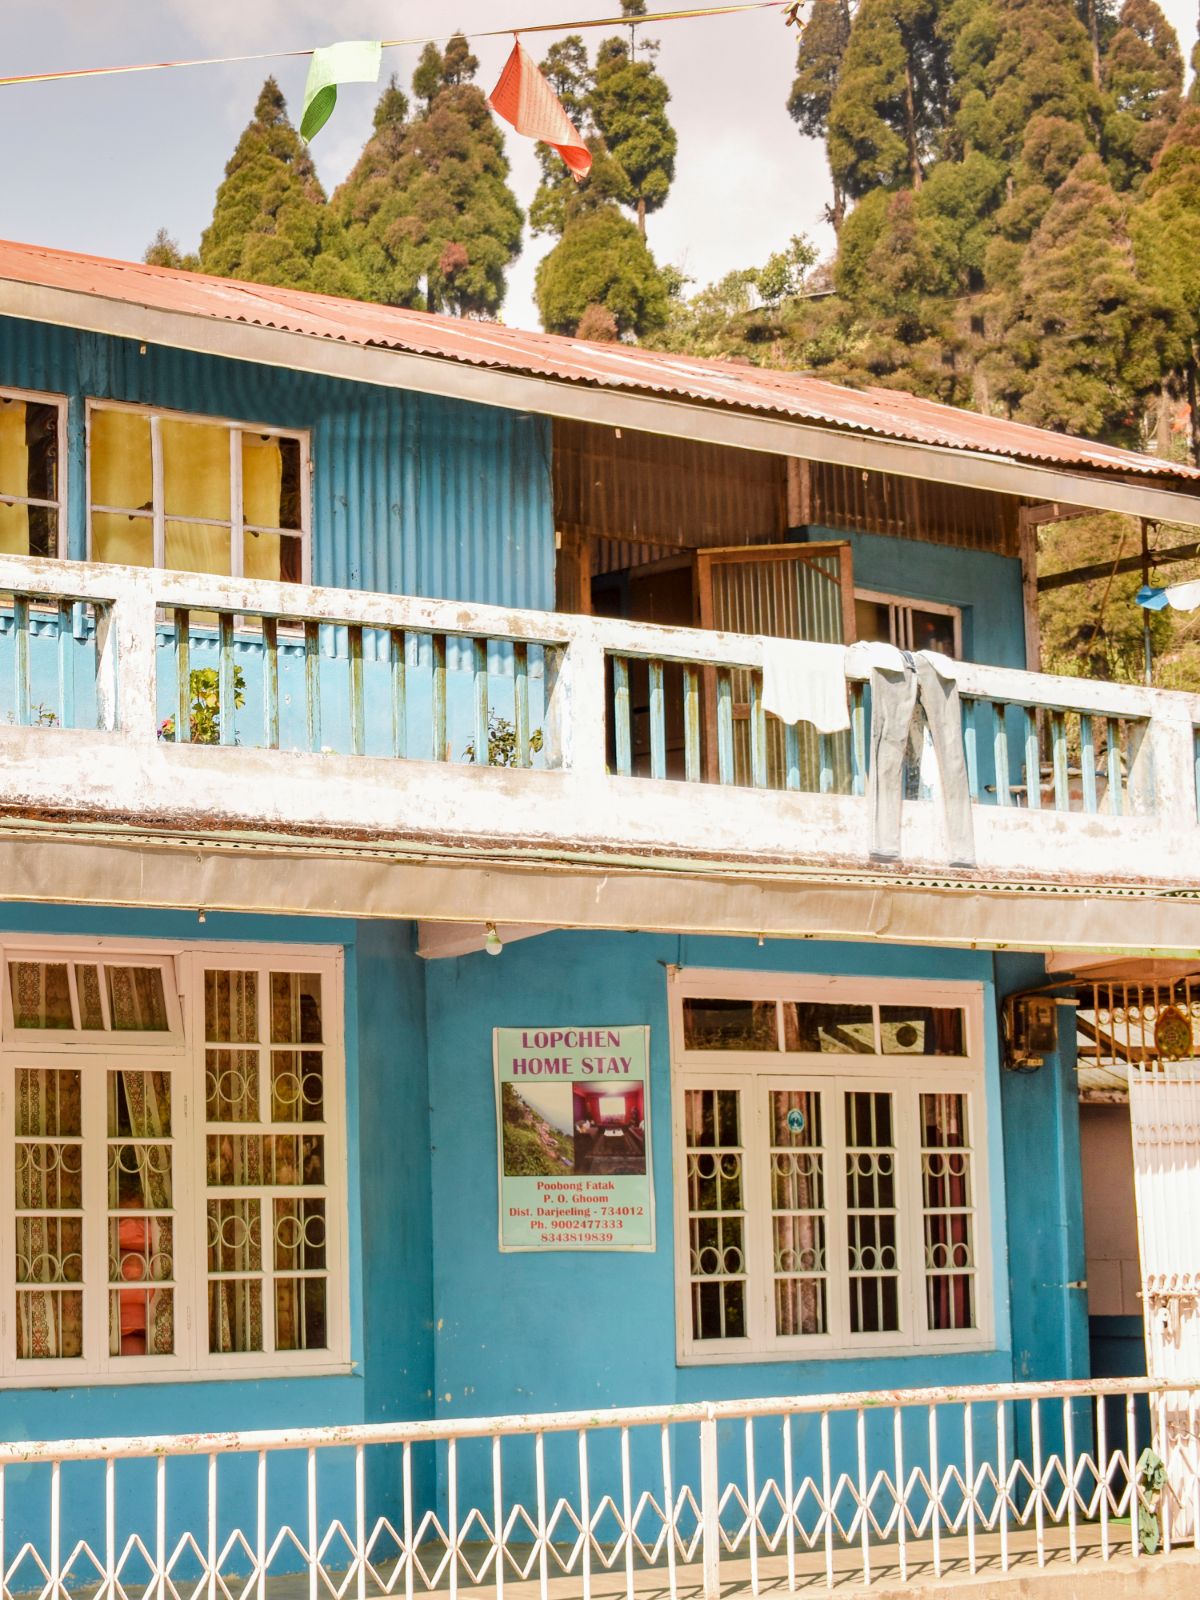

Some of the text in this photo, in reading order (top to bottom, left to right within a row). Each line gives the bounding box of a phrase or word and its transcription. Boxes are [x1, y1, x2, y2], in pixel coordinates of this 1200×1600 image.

[522, 1031, 620, 1049] LOPCHEN
[512, 1056, 632, 1075] HOME STAY
[537, 1181, 615, 1191] Poobong Fatak
[543, 1194, 609, 1203] P. O. Ghoom
[509, 1207, 533, 1216] Dist.
[537, 1207, 590, 1218] Darjeeling
[601, 1207, 644, 1216] 734012
[530, 1219, 623, 1229] Ph. 9002477333
[541, 1233, 613, 1242] 8343819839
